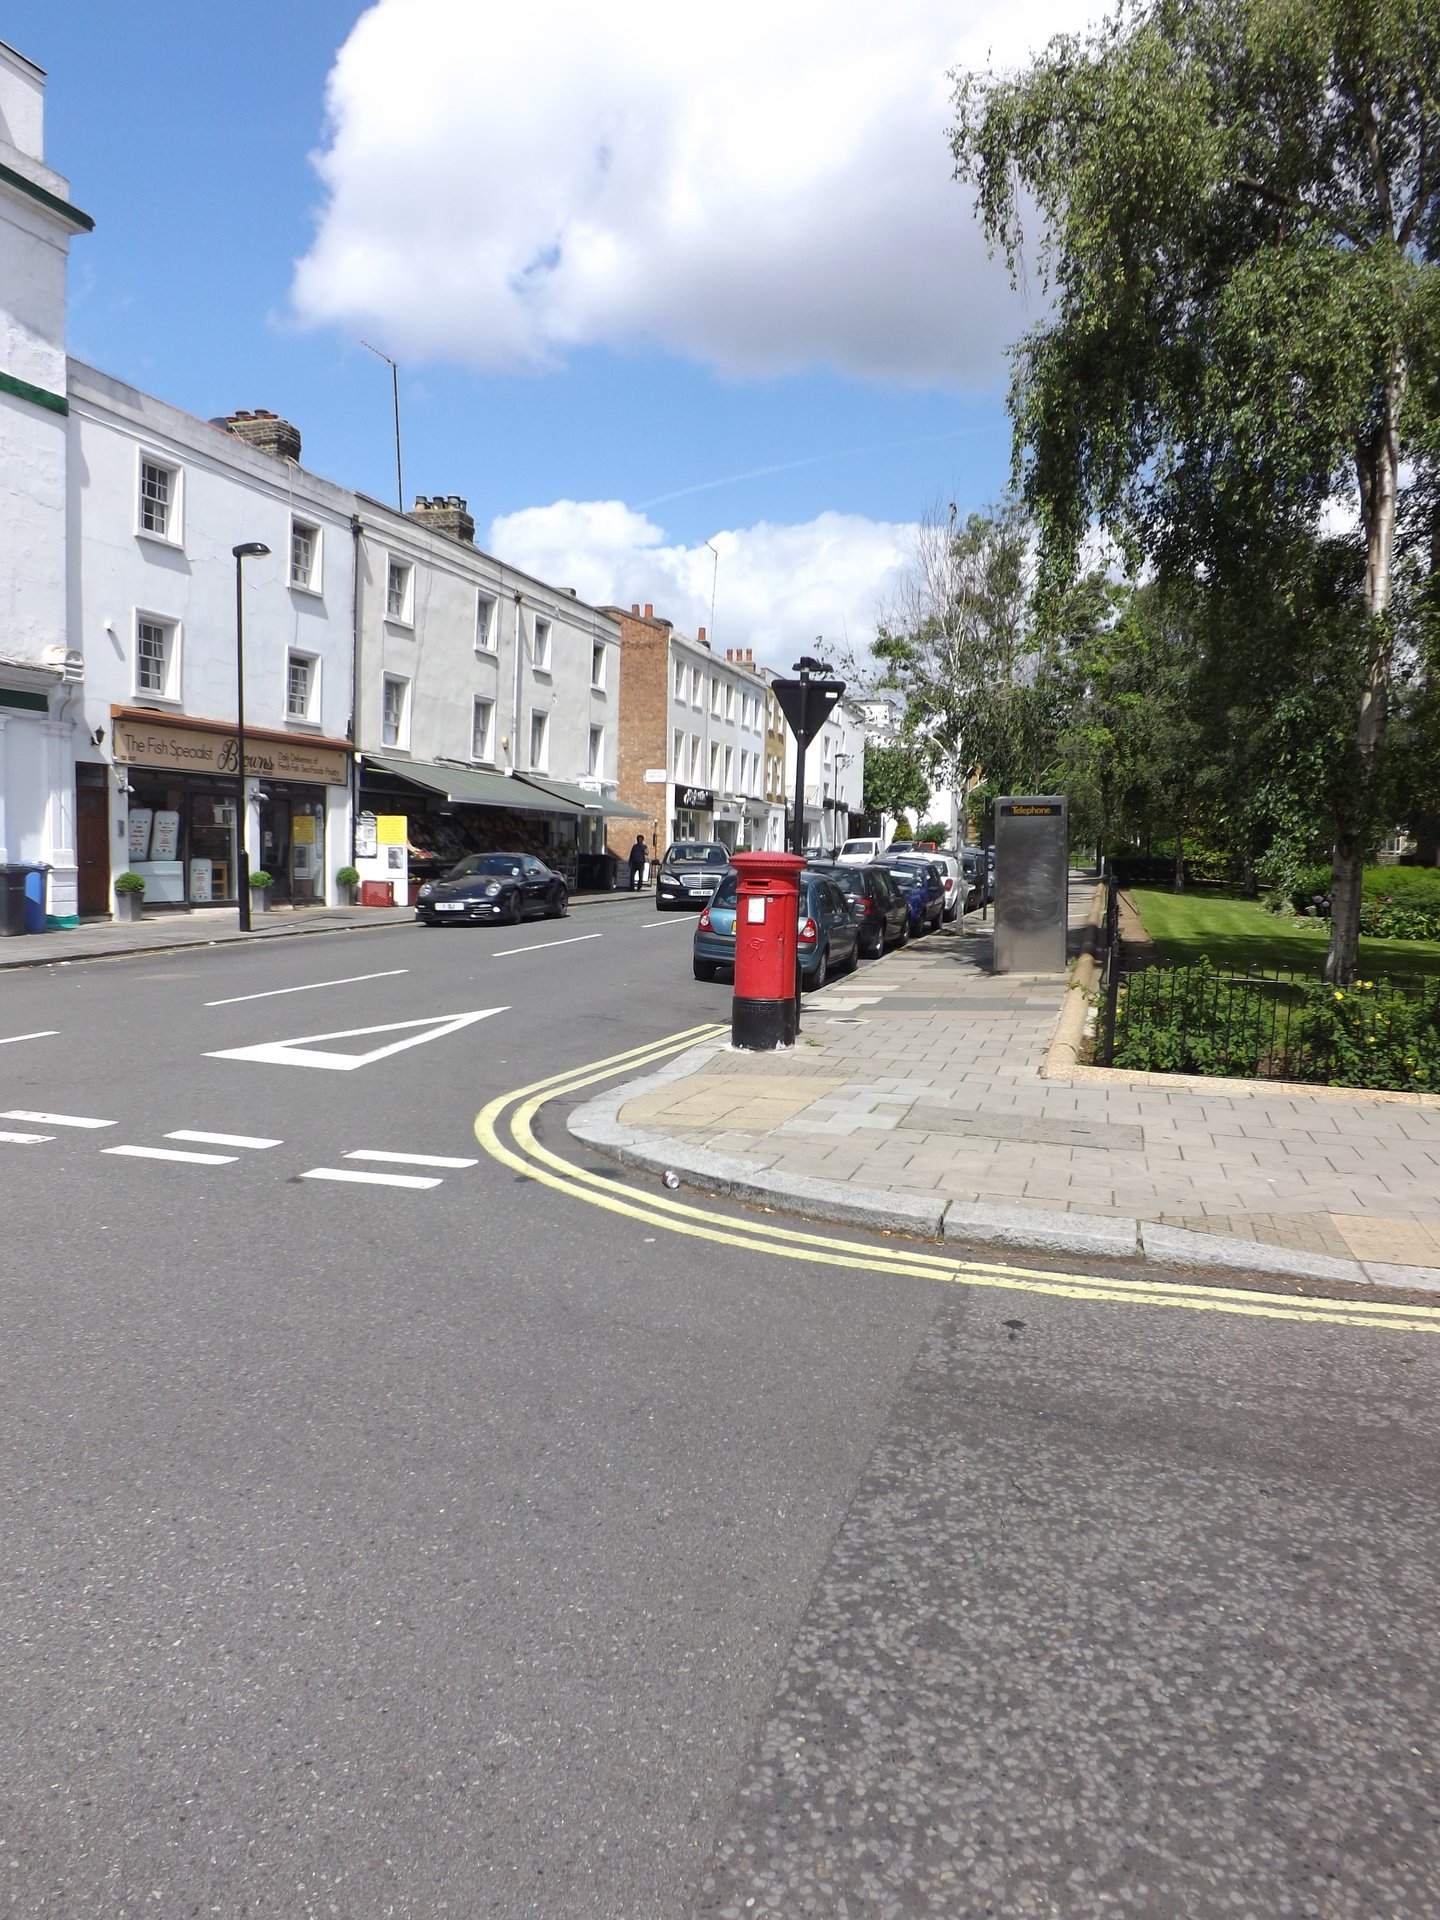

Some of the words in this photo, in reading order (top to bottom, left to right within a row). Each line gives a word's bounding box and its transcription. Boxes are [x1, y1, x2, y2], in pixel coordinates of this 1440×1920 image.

[124, 733, 145, 752] The
[148, 737, 168, 755] Fish
[170, 740, 213, 761] Specialist
[217, 739, 274, 773] Bowns
[1011, 805, 1052, 816] Telephone
